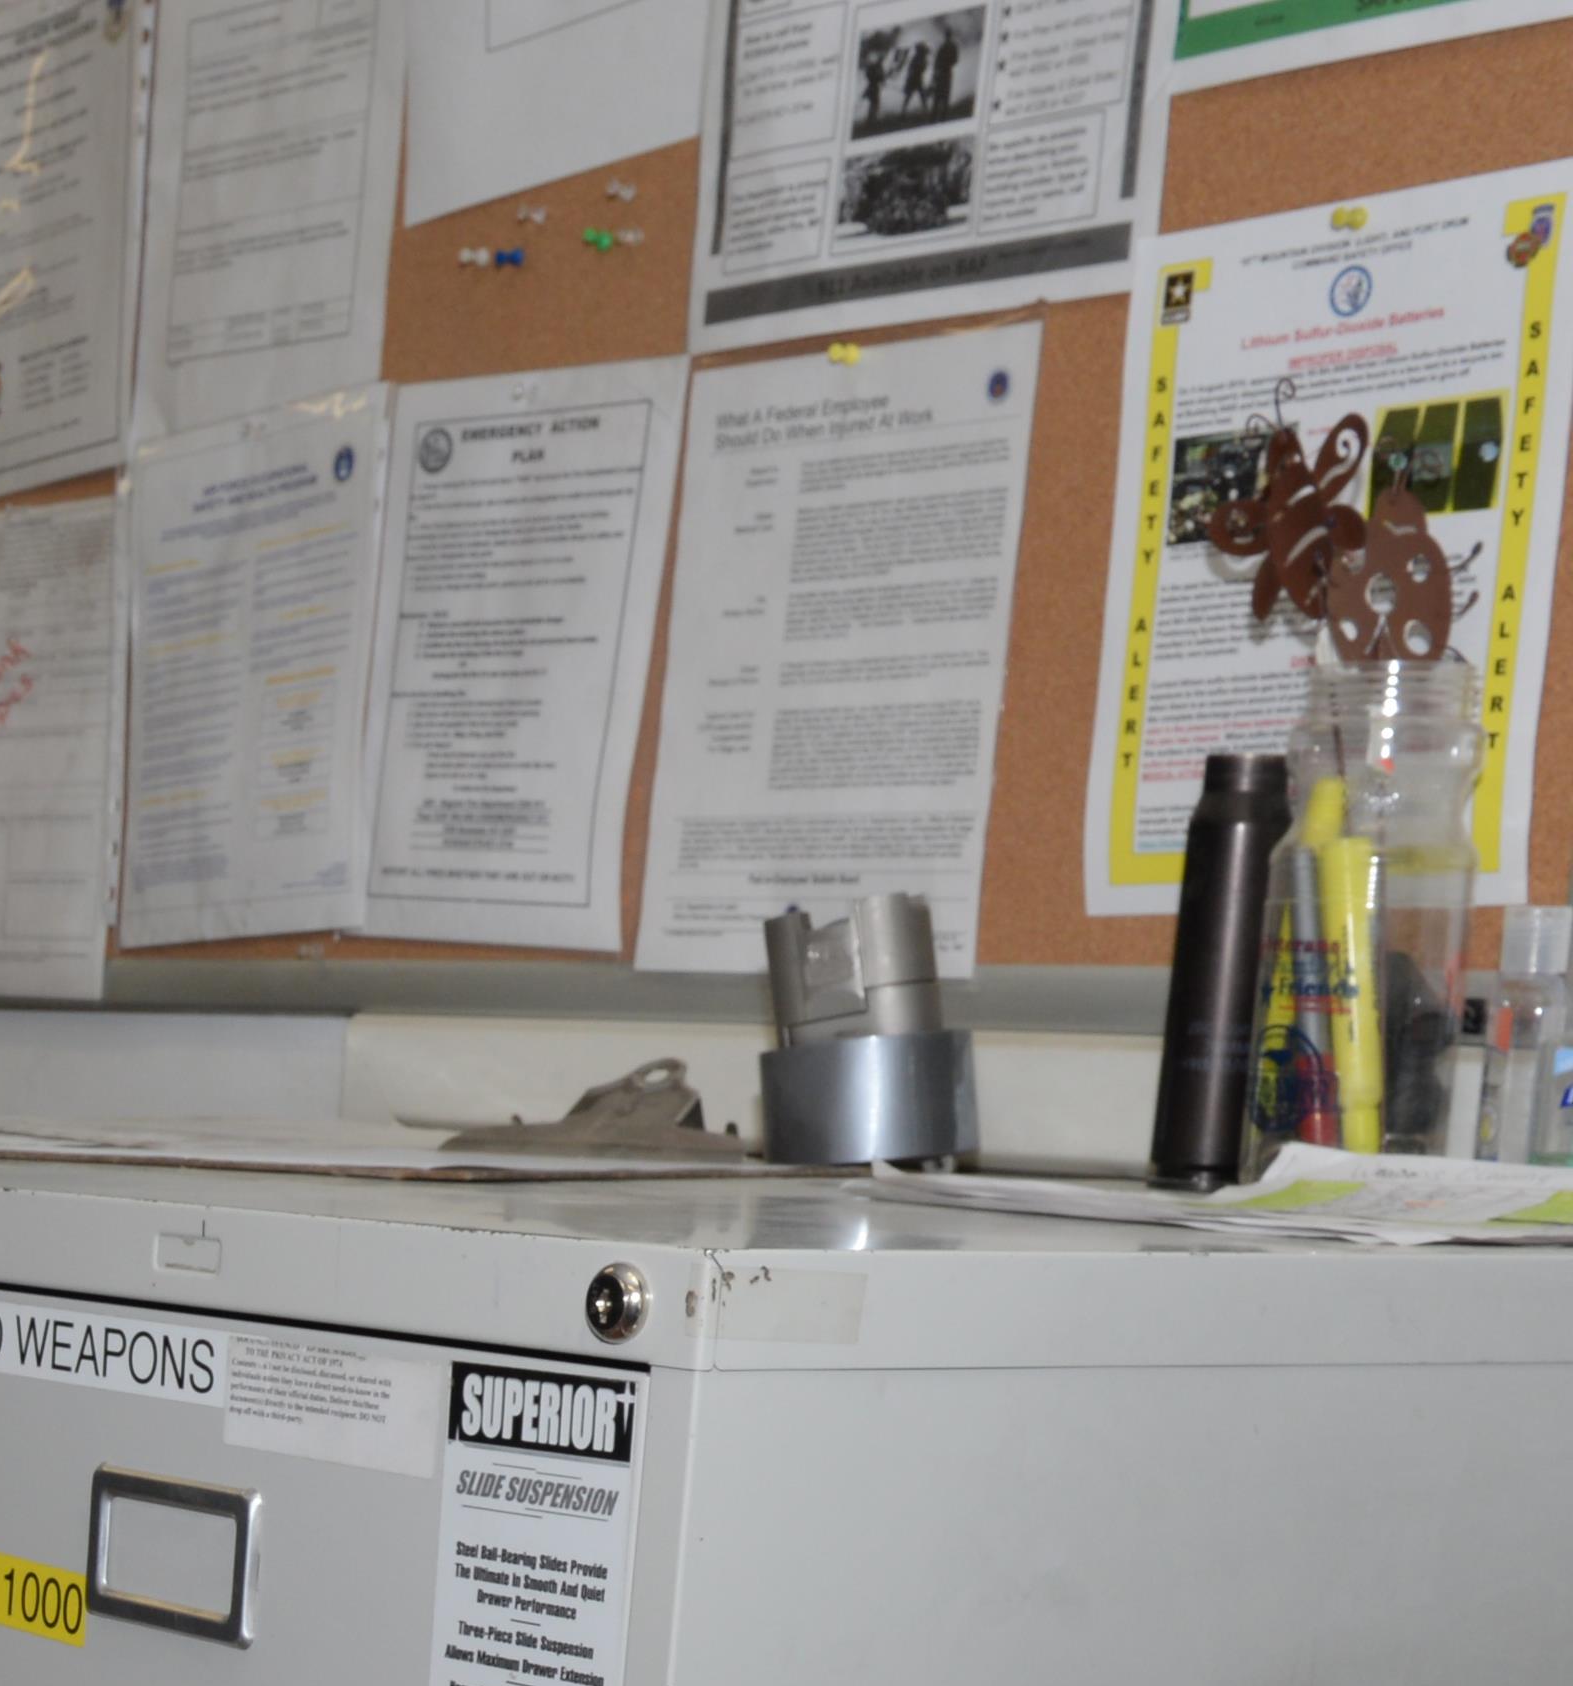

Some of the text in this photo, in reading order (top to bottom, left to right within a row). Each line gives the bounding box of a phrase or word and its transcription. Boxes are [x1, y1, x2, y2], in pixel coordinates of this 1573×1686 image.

[766, 403, 818, 422] Federal
[822, 395, 890, 417] Employee
[460, 416, 601, 444] EMERGENCY ACTION
[716, 431, 758, 451] Should
[16, 1313, 215, 1395] WEAPONS
[462, 1373, 617, 1452] SUPERIOR
[456, 1469, 620, 1516] SLIDE SUSPENSION
[456, 1541, 608, 1580] Steel Ball-Bearing Slides Provide
[455, 1563, 606, 1602] The Ultimate In Smooth And Quiet
[3, 1568, 84, 1637] 1000
[477, 1589, 577, 1620] Drawer Performance
[459, 1620, 594, 1660] Three-Piece Slide Suspension
[445, 1644, 474, 1663] Allows
[476, 1651, 520, 1672] Maximum
[522, 1658, 558, 1680] Drawer
